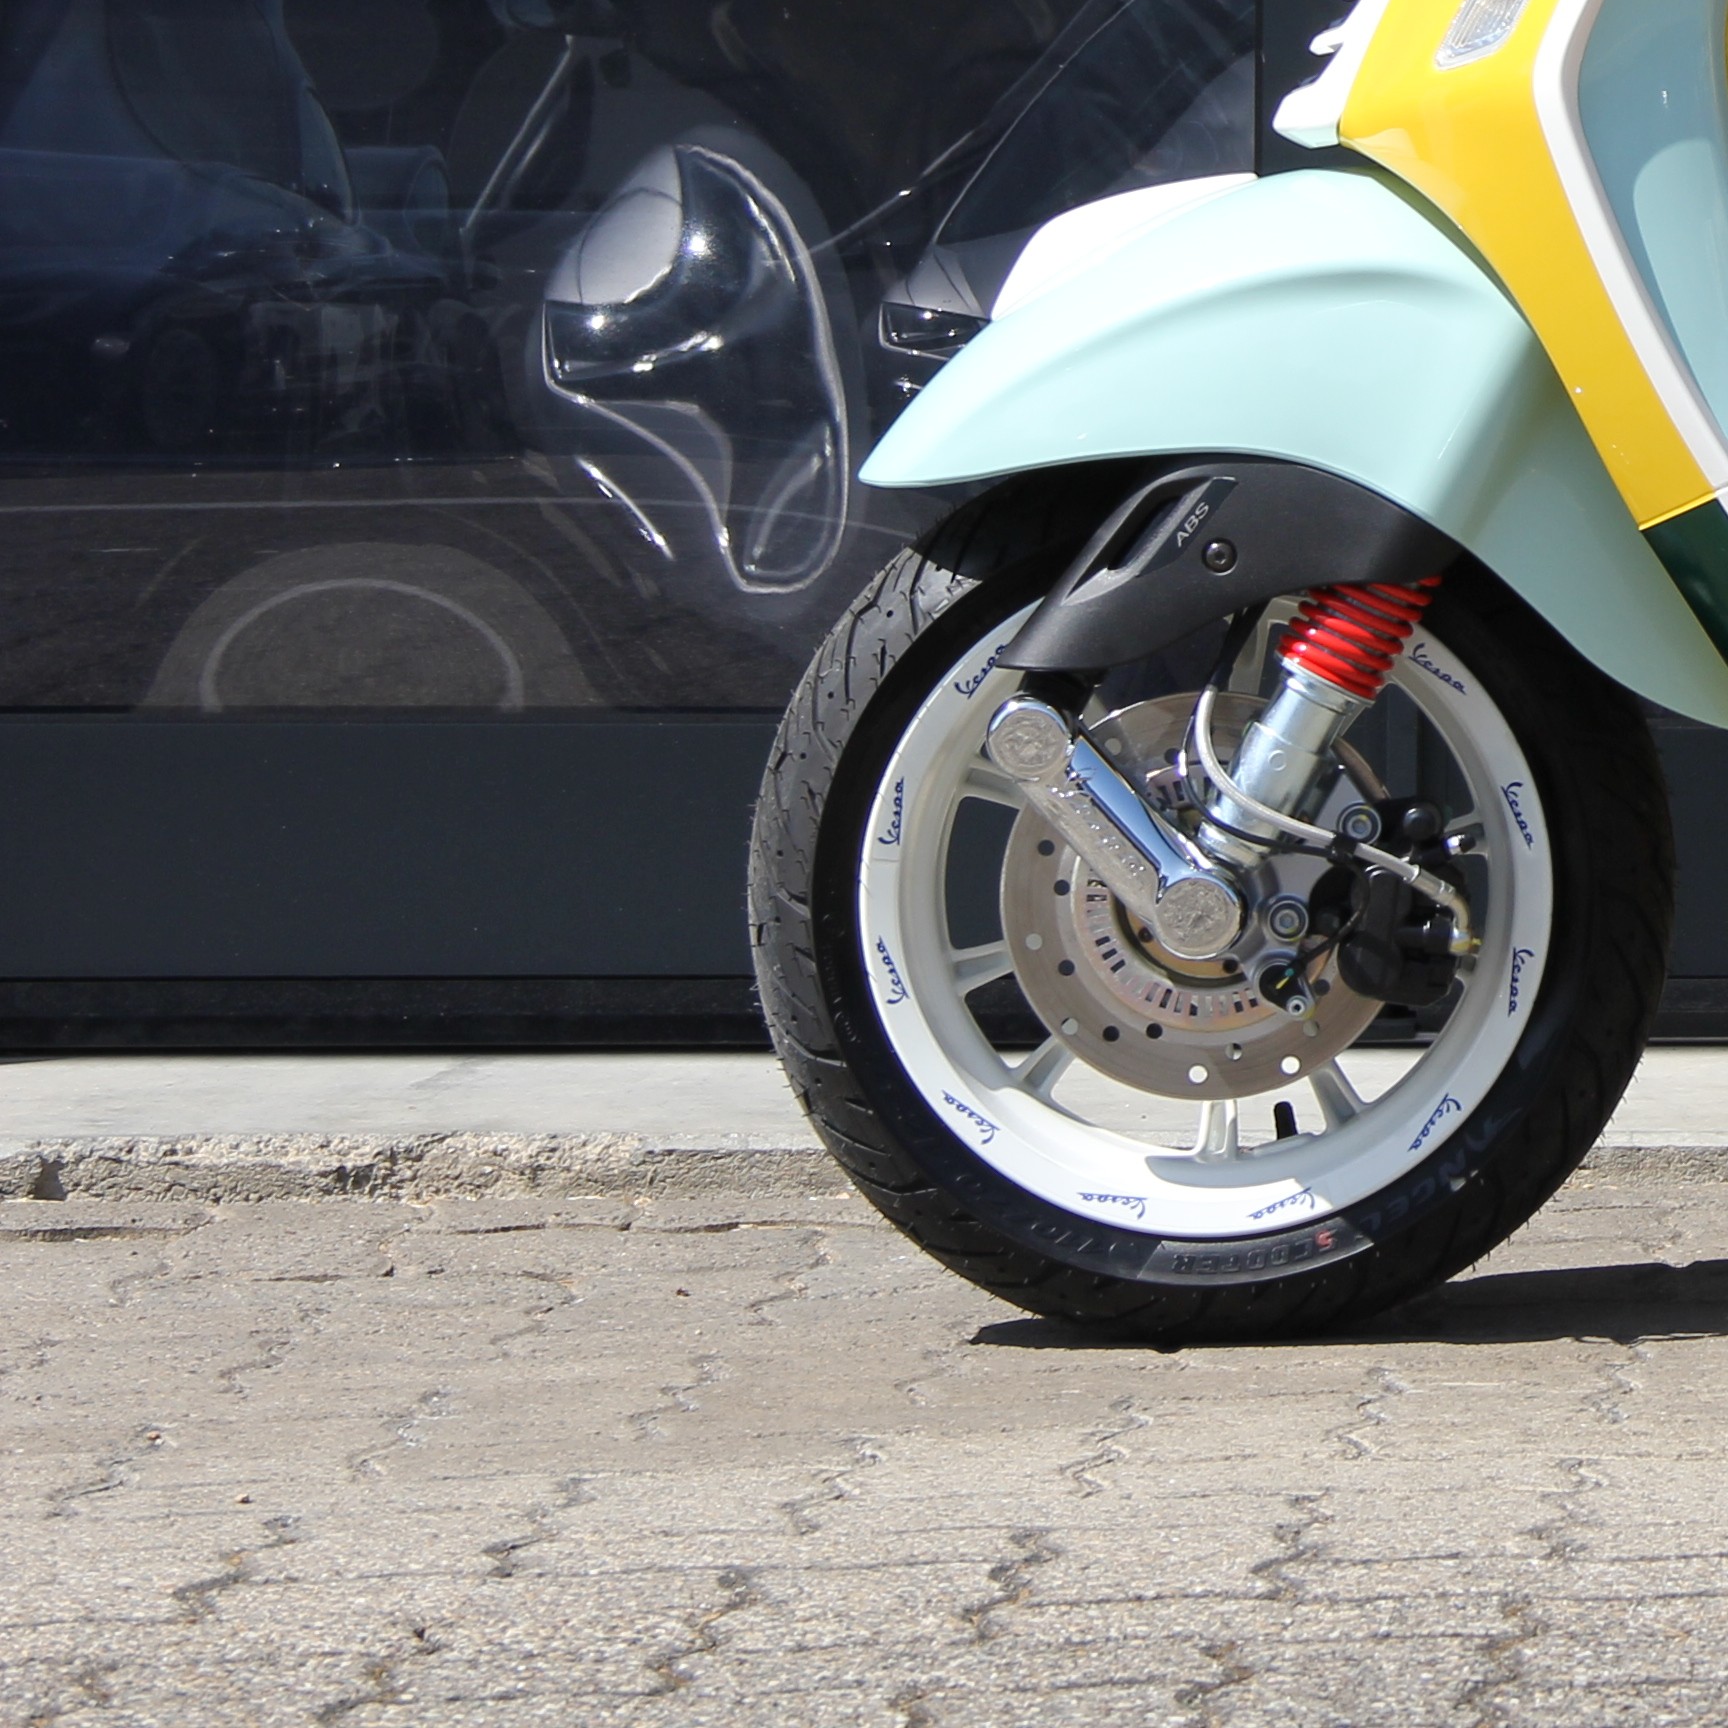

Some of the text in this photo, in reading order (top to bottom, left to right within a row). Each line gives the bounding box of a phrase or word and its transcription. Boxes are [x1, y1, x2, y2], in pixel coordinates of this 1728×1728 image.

[1176, 501, 1210, 549] ABS
[1408, 642, 1467, 696] Vespa
[879, 776, 905, 847] Vespa
[1501, 781, 1535, 851] Vespa
[876, 935, 910, 1005] Vespa
[1511, 946, 1536, 1018] Vespa
[942, 1089, 1000, 1145] Vespa
[1407, 1092, 1463, 1153] Vespa
[1076, 1191, 1148, 1220] Vespa
[1246, 1186, 1316, 1221] Vespa
